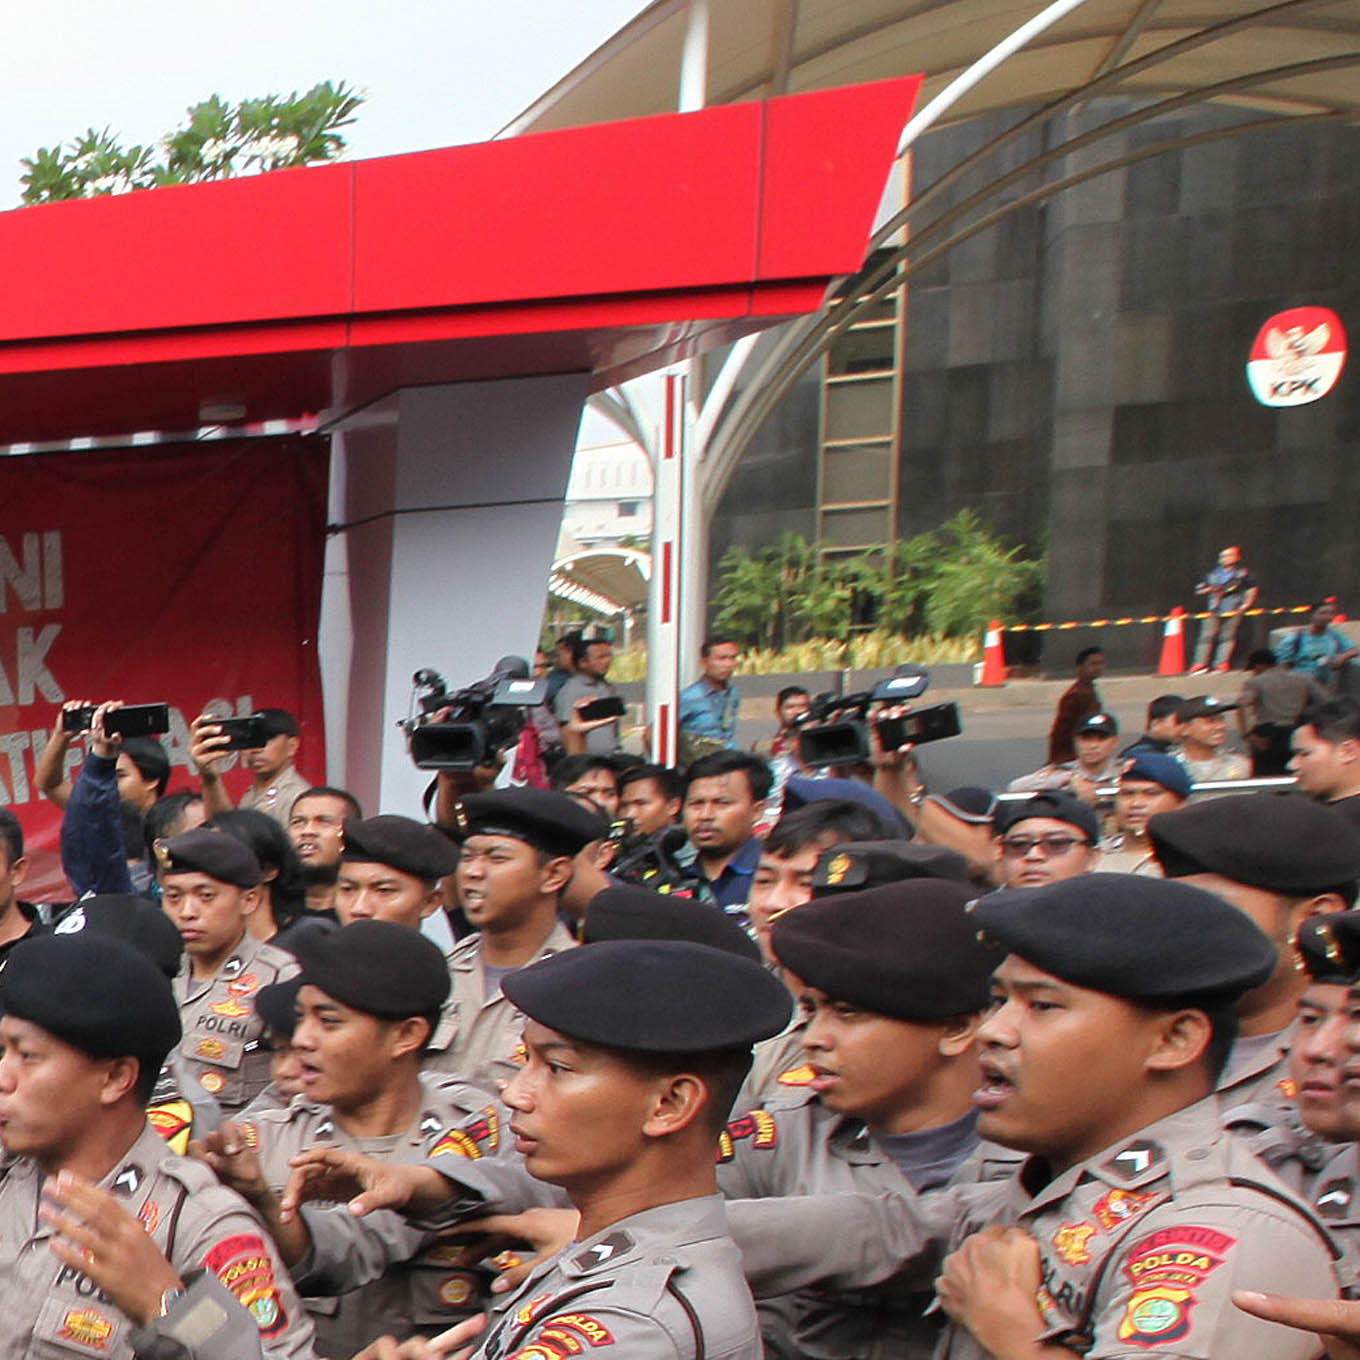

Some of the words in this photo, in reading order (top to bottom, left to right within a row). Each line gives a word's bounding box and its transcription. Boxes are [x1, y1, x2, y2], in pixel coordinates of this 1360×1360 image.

[196, 1016, 248, 1040] POLRI
[1130, 1252, 1211, 1277] POLDA
[551, 1316, 607, 1342] POLDA
